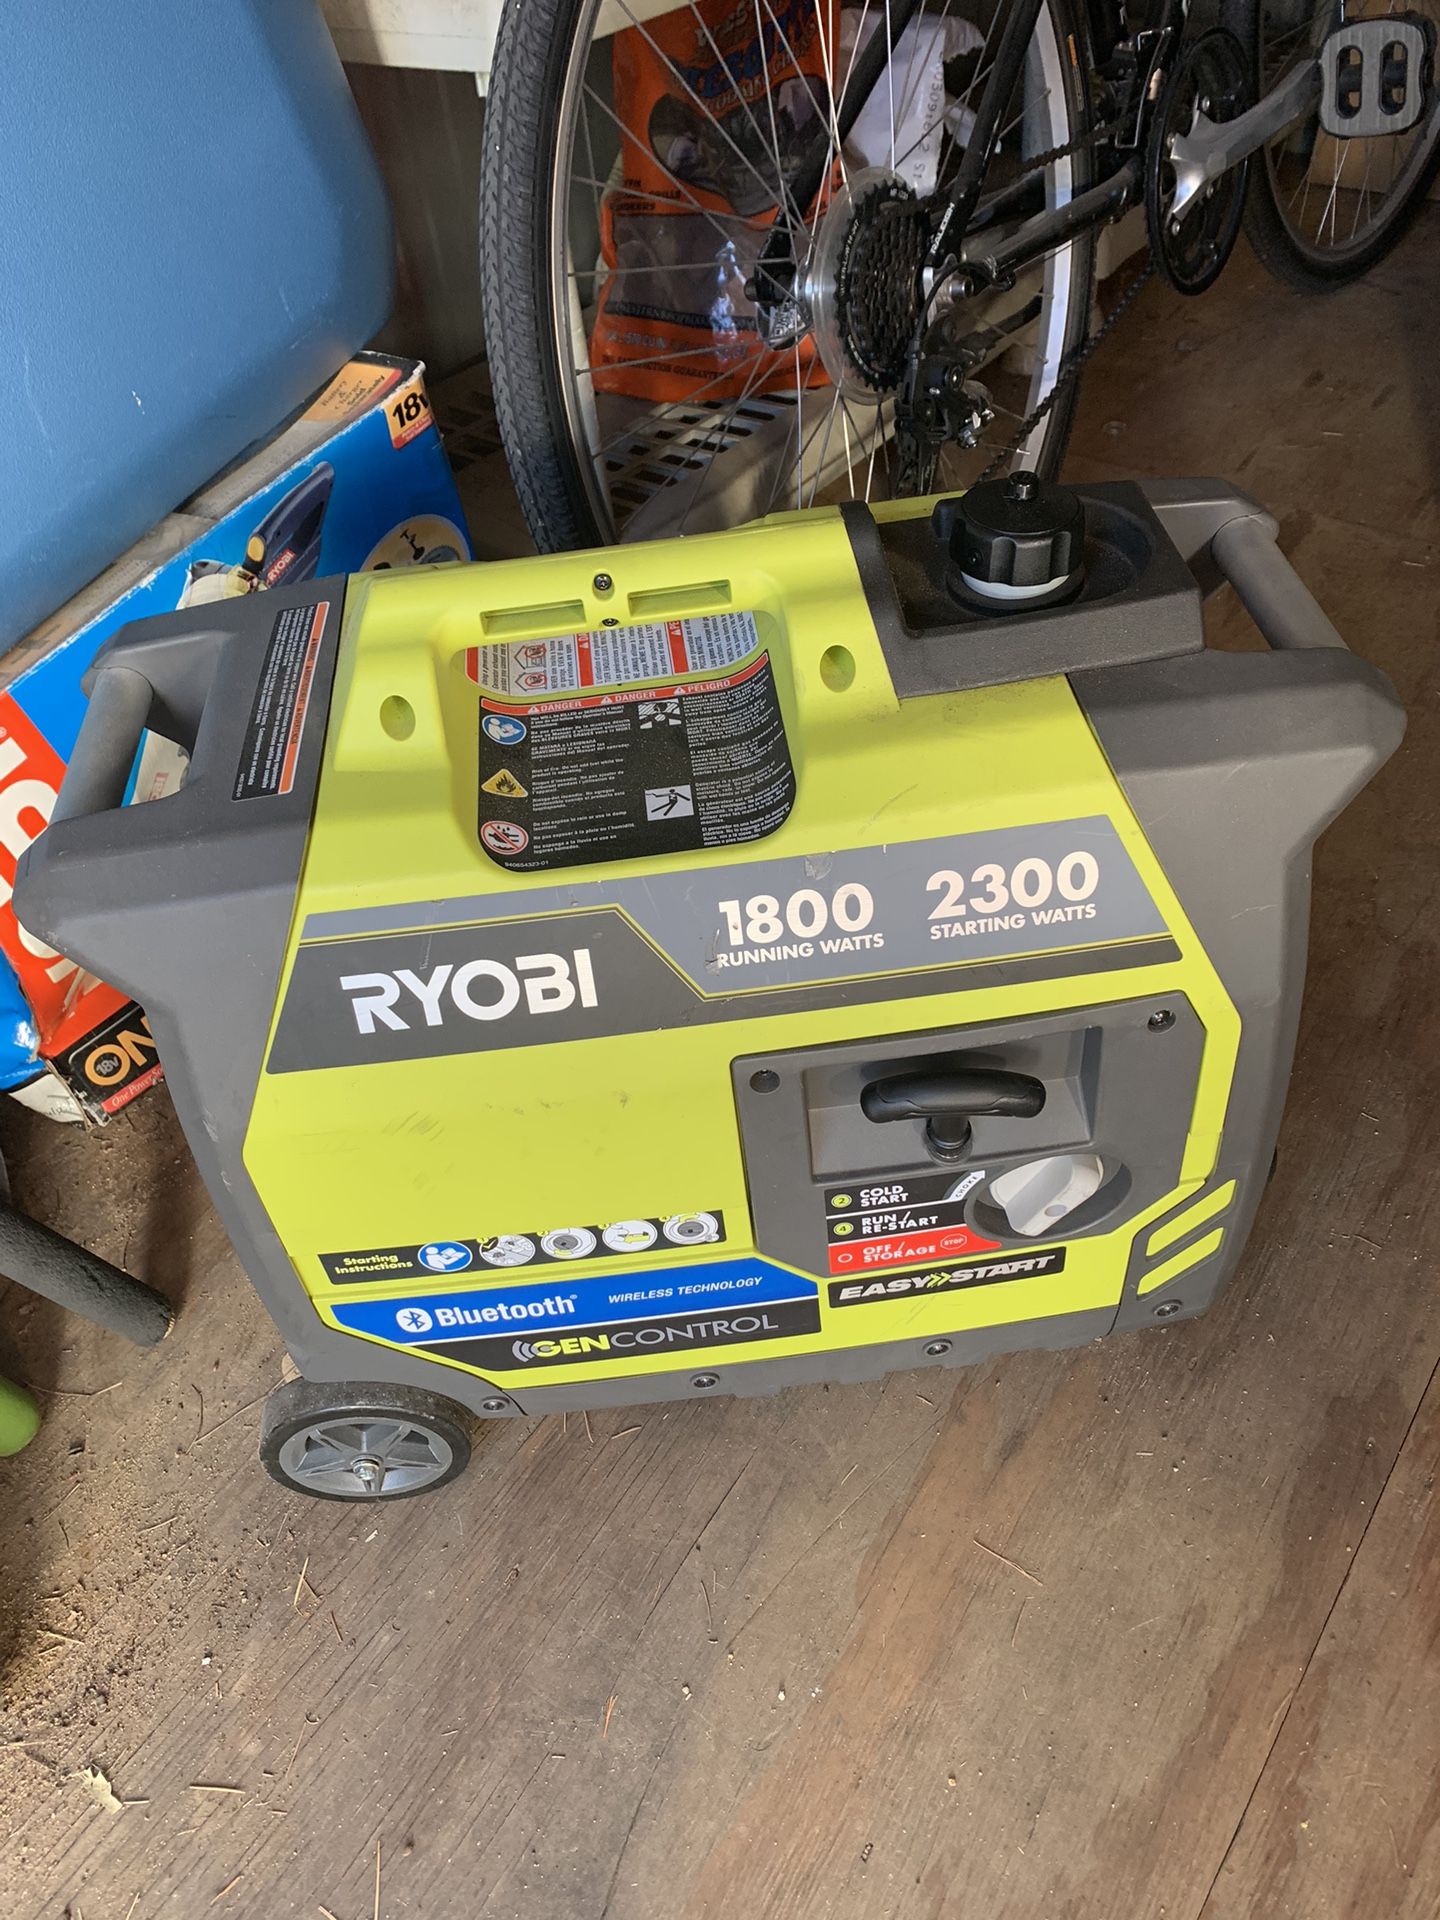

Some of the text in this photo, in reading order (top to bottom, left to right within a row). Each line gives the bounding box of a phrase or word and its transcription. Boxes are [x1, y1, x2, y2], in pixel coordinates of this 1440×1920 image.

[540, 679, 730, 713] DANGER DANGER PELIGRO
[718, 851, 1099, 946] 1800 2300
[717, 903, 1097, 969] RUNNING WATTS STARTING WATTS
[339, 948, 598, 1034] RYOBI
[111, 1091, 129, 1107] One
[860, 1185, 904, 1198] COLD
[955, 1174, 979, 1198] CHOKE
[860, 1192, 909, 1207] START
[862, 1215, 938, 1235] RE-START
[943, 1235, 964, 1246] STOP
[343, 1254, 399, 1266] Starting
[863, 1245, 936, 1263] STORAGE
[335, 1260, 413, 1275] Instructions
[608, 1287, 673, 1304] WIRELESS
[678, 1276, 763, 1297] TECHNOLOGY
